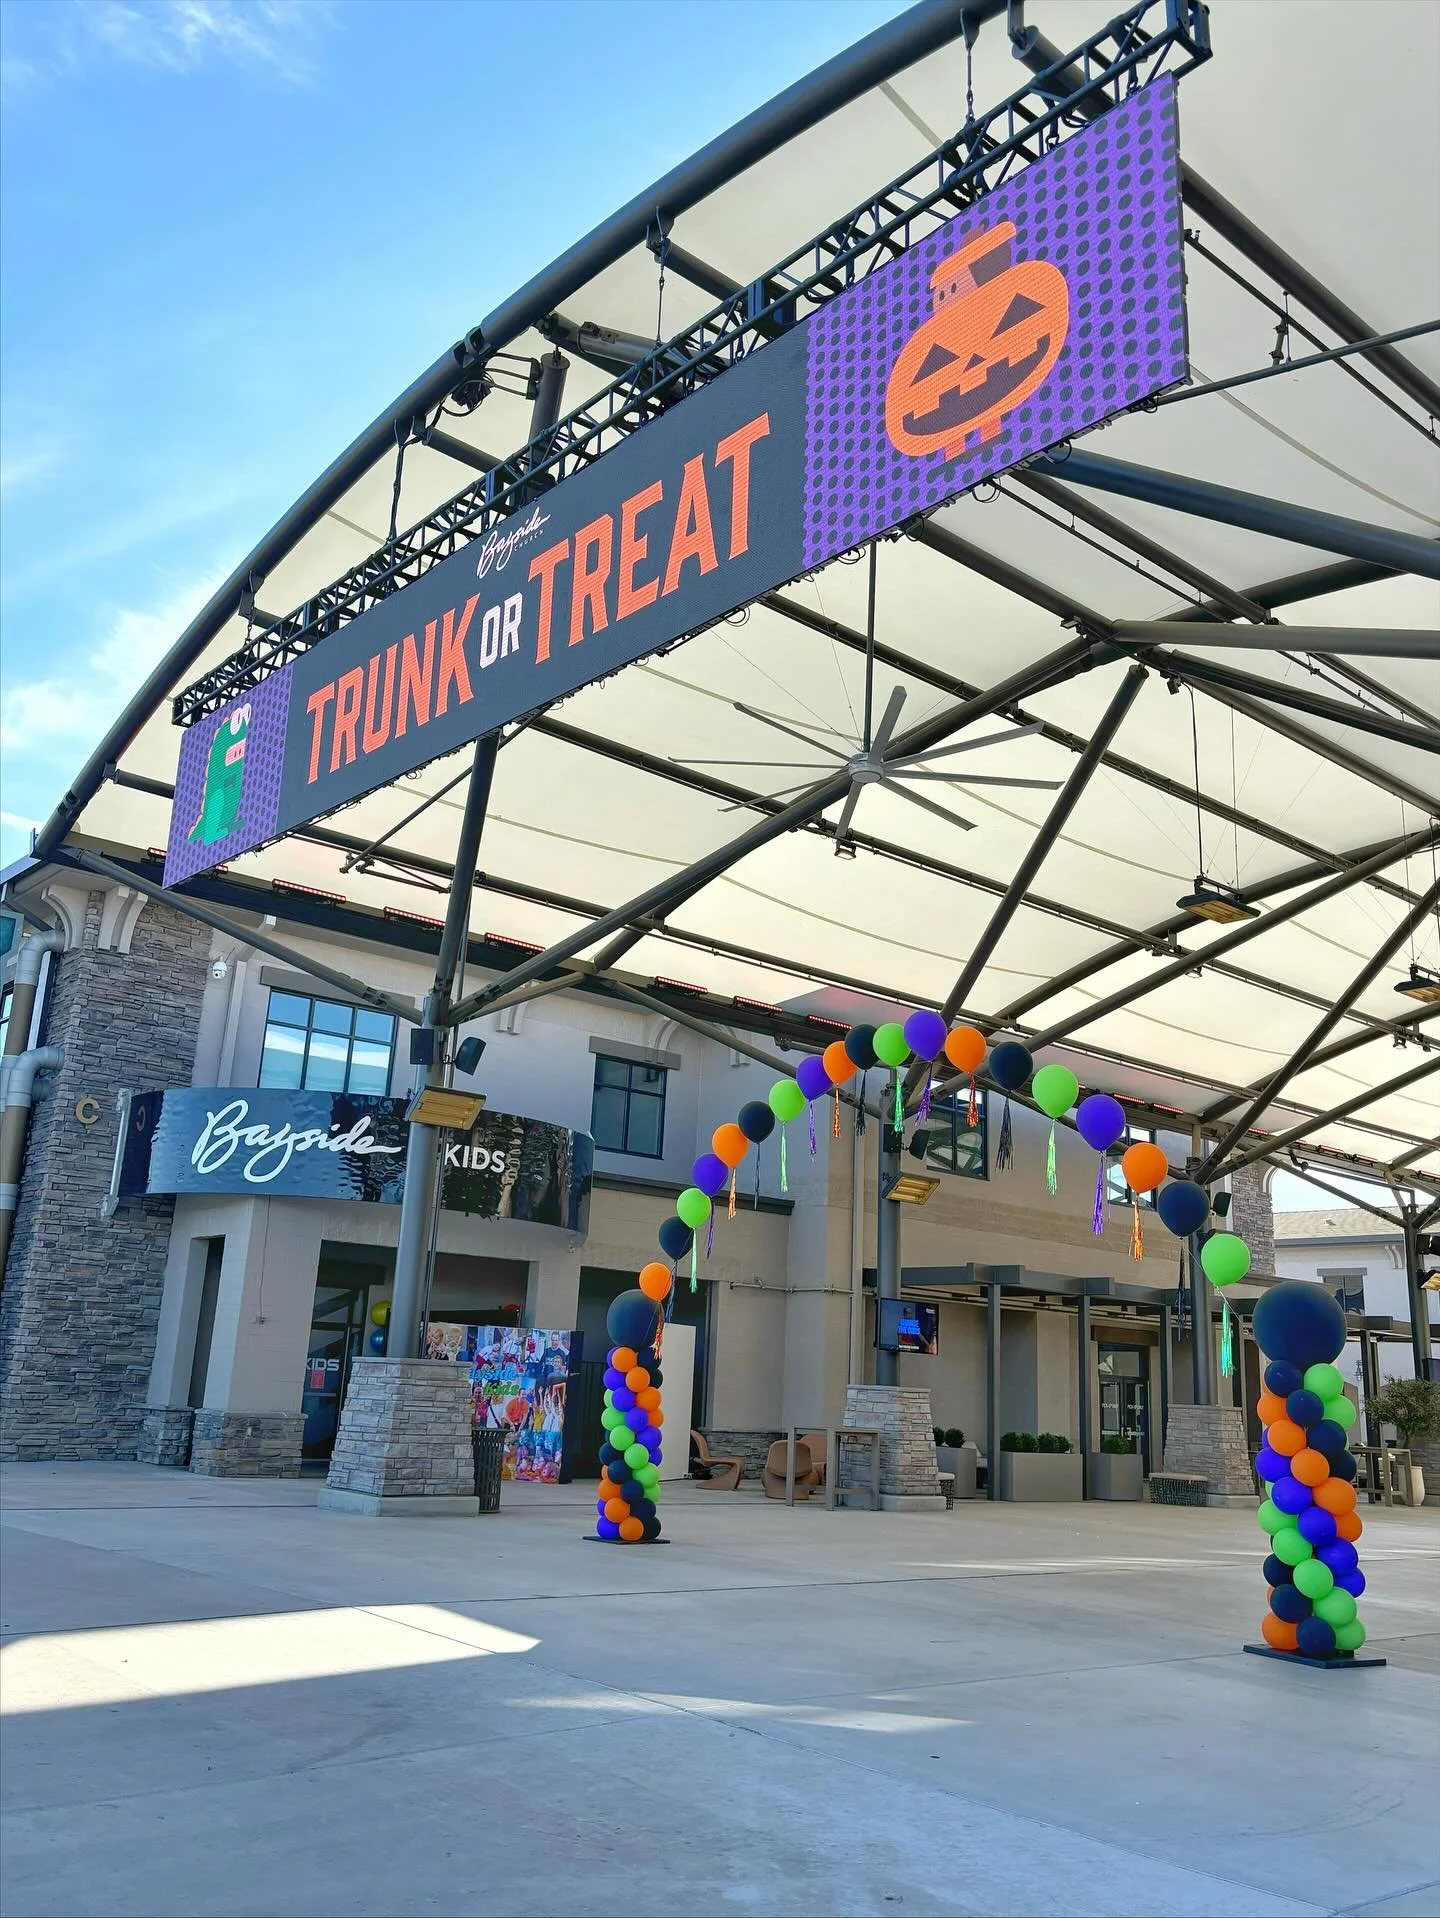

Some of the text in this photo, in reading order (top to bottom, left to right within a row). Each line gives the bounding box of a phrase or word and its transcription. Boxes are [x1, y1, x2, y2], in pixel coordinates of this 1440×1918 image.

[476, 506, 552, 580] Bayside
[514, 529, 544, 552] CHURCH
[306, 411, 772, 785] TRUNK OR TREAT
[75, 1096, 100, 1125] C
[191, 1099, 506, 1183] Bayside KIDS
[305, 1357, 340, 1372] KIDS
